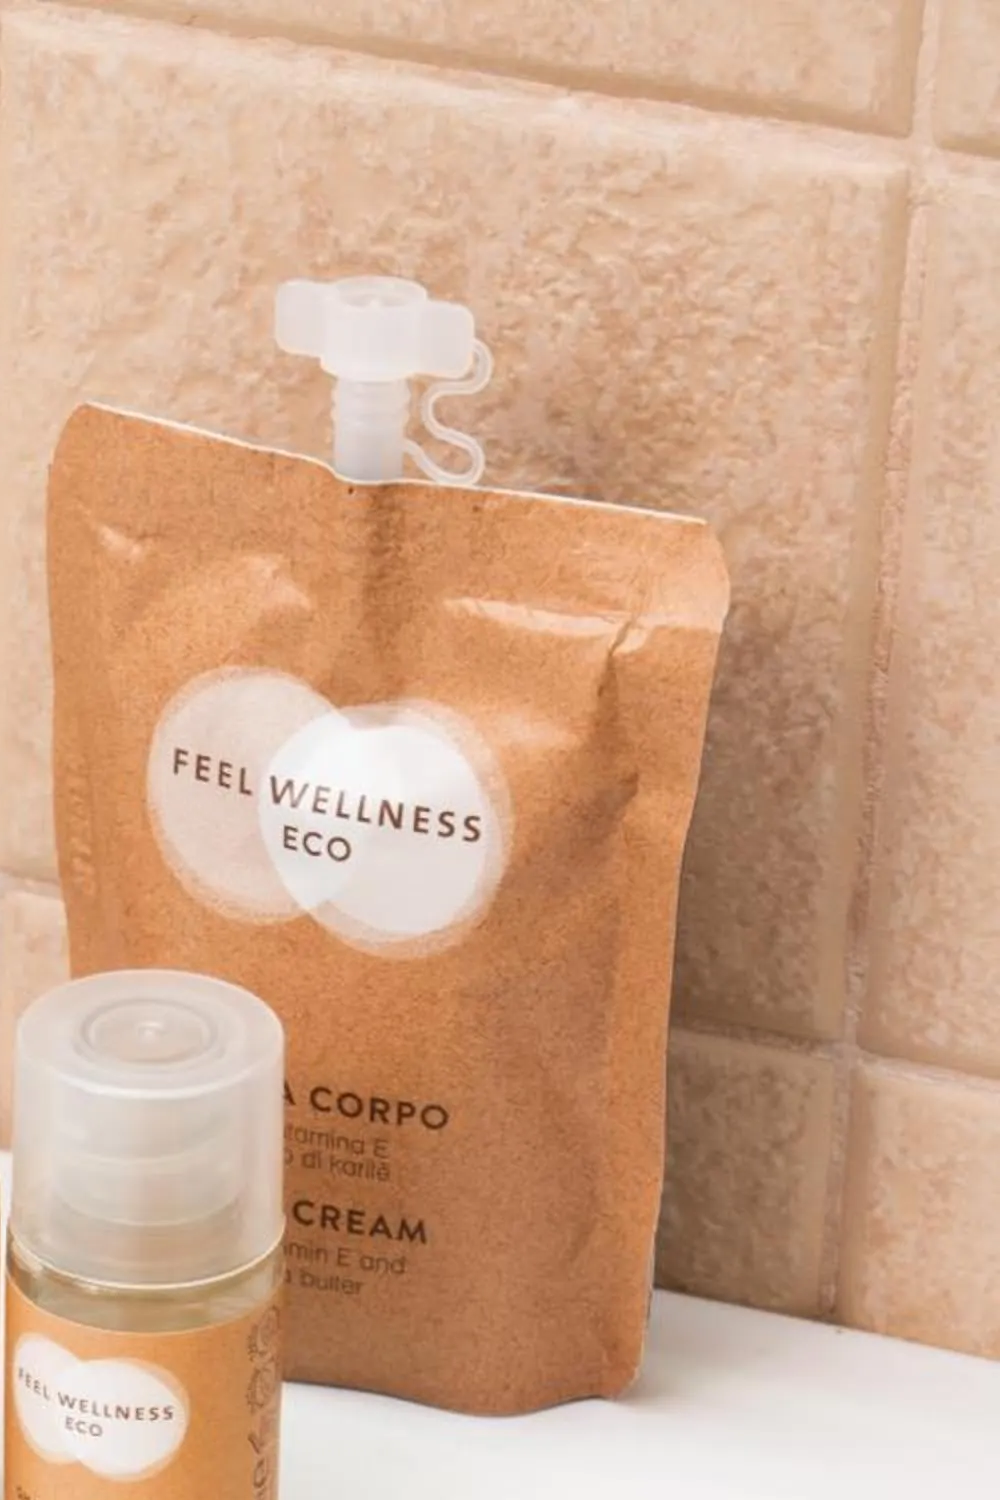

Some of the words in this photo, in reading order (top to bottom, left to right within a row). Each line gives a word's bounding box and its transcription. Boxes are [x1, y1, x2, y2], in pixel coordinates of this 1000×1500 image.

[173, 748, 252, 796] FEEL
[270, 775, 481, 842] WELLNESS
[282, 825, 351, 862] ECO
[310, 1086, 449, 1130] CORPO
[373, 1138, 389, 1159] E
[292, 1200, 427, 1245] CREAM
[337, 1247, 350, 1267] E
[359, 1254, 406, 1275] and
[18, 1367, 51, 1400] FEEL
[57, 1391, 175, 1422] WELLNESS
[64, 1416, 103, 1437] ECO
